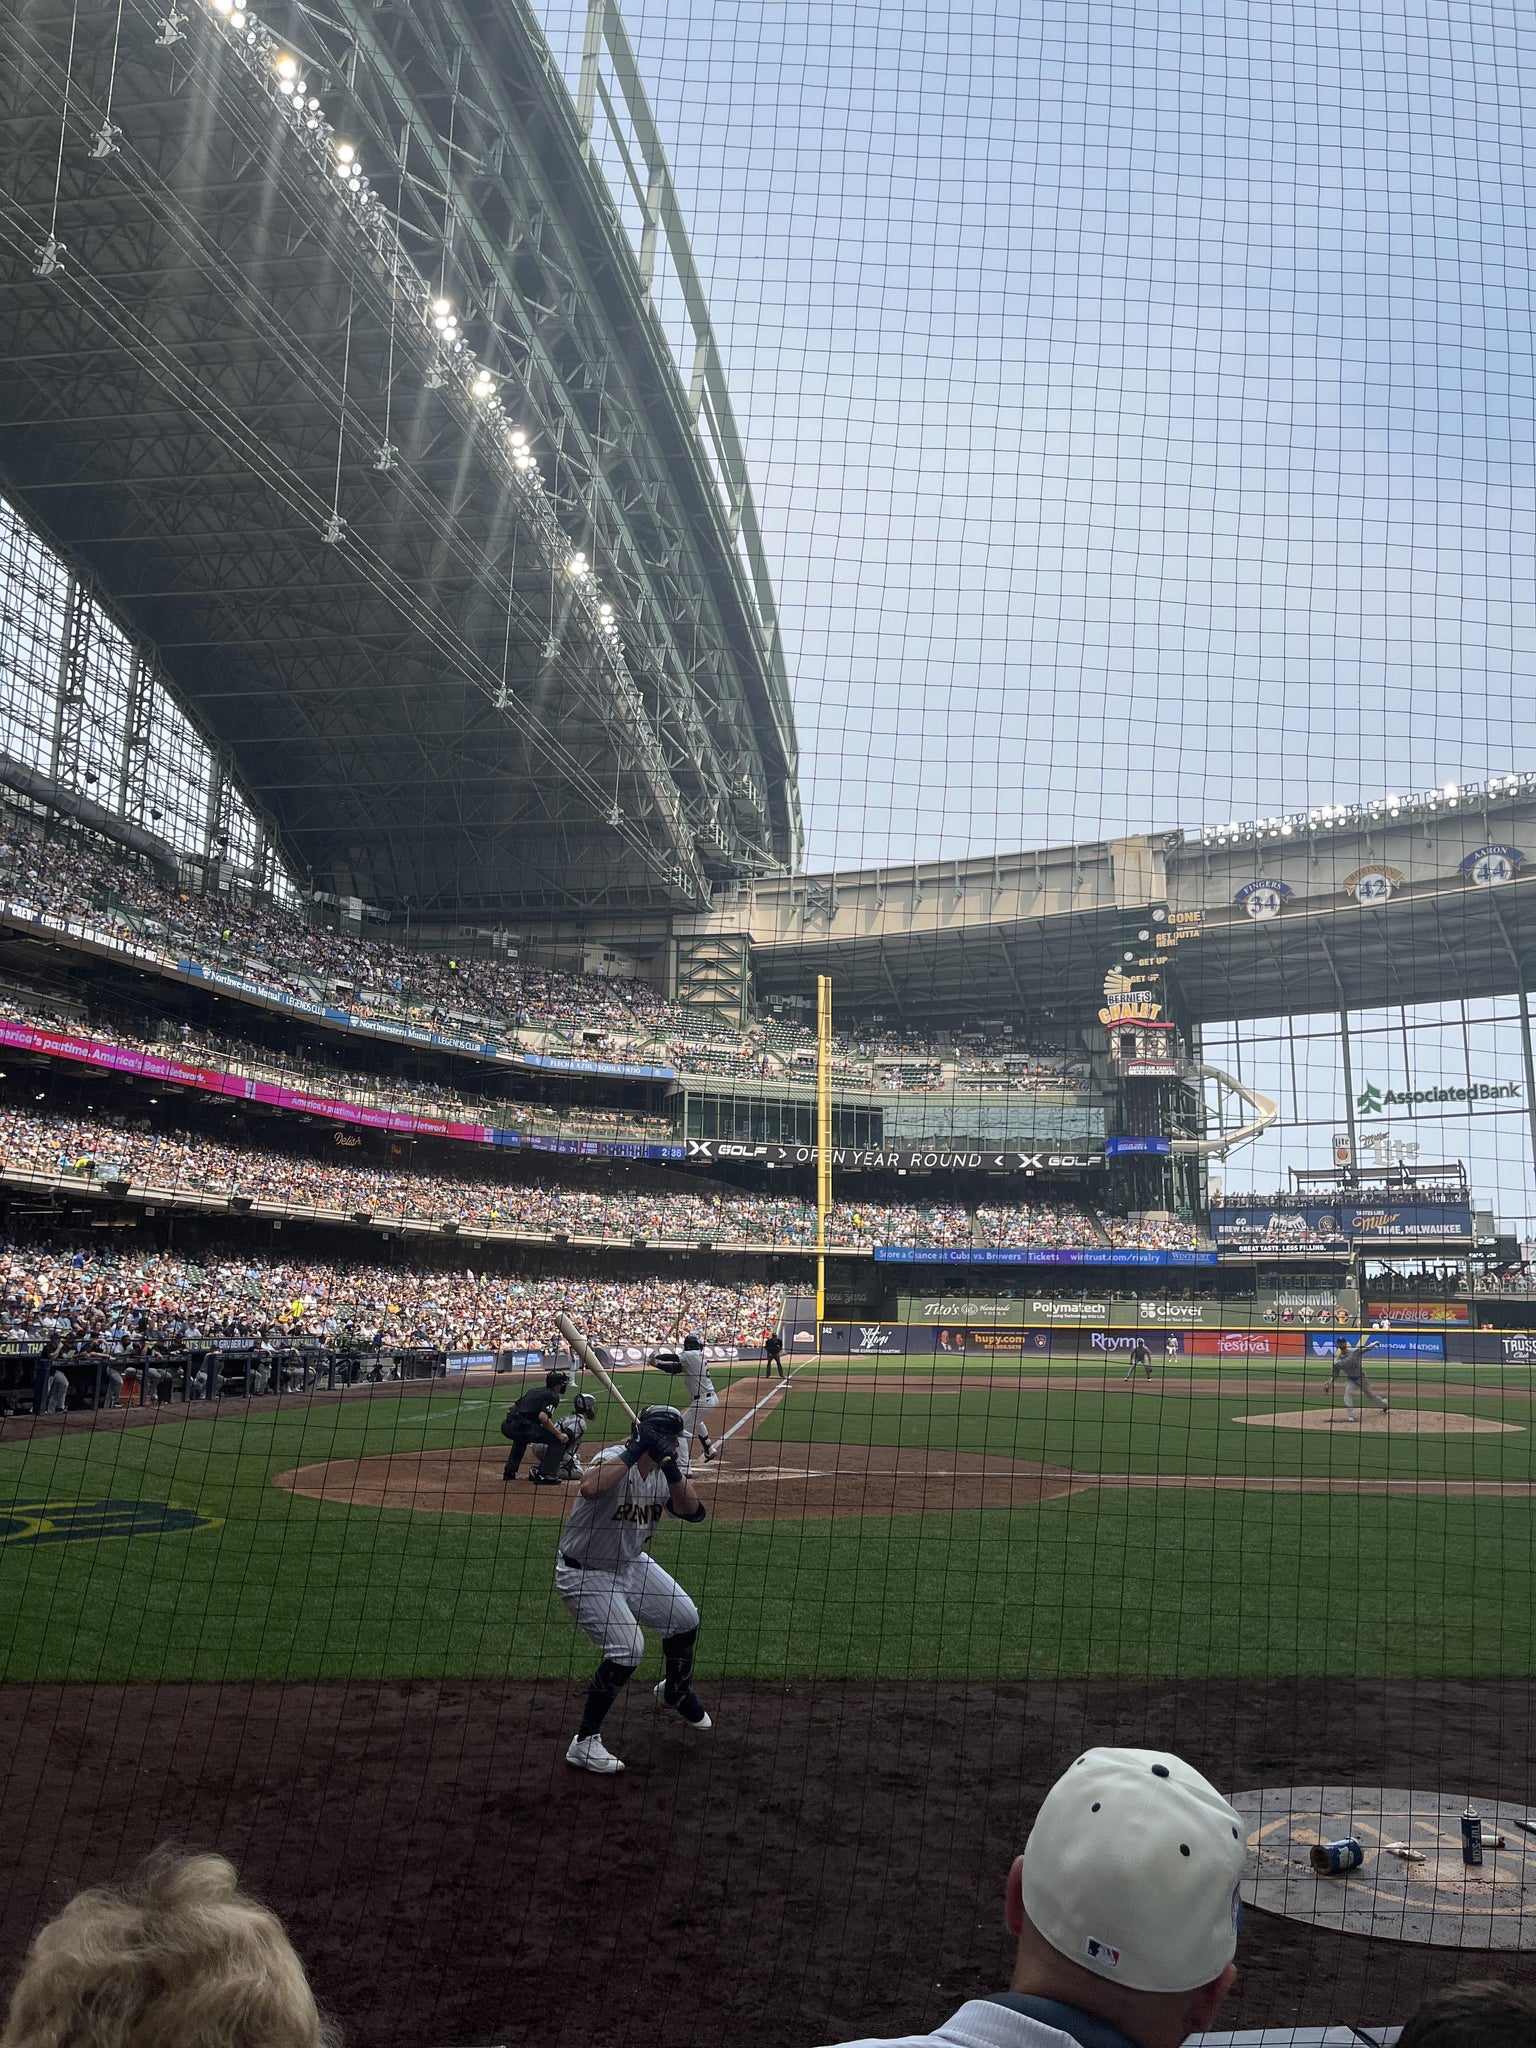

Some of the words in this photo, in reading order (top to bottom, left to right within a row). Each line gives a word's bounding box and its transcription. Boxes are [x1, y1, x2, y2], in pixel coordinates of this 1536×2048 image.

[1474, 846, 1508, 859] AARON
[1350, 864, 1396, 881] ROBINSON
[1477, 860, 1507, 881] 44
[1243, 880, 1282, 895] FINGERS
[1359, 879, 1387, 898] 42
[1250, 894, 1276, 913] 34
[1167, 911, 1206, 924] GONE!
[1155, 932, 1174, 941] GET
[1175, 929, 1200, 939] OUTTA
[1138, 957, 1154, 967] GET
[1156, 956, 1169, 965] UP
[1130, 974, 1146, 983] GET
[1148, 973, 1160, 982] UP
[210, 972, 256, 994] Northwestern
[257, 986, 280, 1001] Mutual
[1107, 991, 1152, 1006] BERNIE'S
[286, 996, 311, 1013] LEGENDS
[311, 1004, 326, 1017] CLUB
[1098, 1003, 1162, 1025] CHALET
[359, 1019, 407, 1037] Northwestern
[408, 1030, 432, 1042] Mutual
[438, 1036, 465, 1049] LEGENDS
[465, 1043, 481, 1052] CLUB
[94, 1049, 142, 1070] America's
[550, 1059, 574, 1069] FLECHA
[576, 1062, 593, 1071] AZUL
[292, 1097, 326, 1114] America's
[357, 1111, 393, 1126] America's
[688, 1141, 713, 1156] X
[718, 1145, 768, 1156] GOLF
[1335, 1137, 1349, 1146] Lite
[661, 1148, 681, 1157] 2:36
[852, 1150, 899, 1167] YEAR
[910, 1153, 982, 1167] ROUND
[1372, 1139, 1419, 1166] Lite
[1018, 1154, 1044, 1168] X
[1048, 1156, 1102, 1166] GOLF
[1218, 1225, 1240, 1233] BREW
[1235, 1217, 1247, 1226] GO
[1352, 1213, 1400, 1233] Miller
[1378, 1225, 1404, 1236] TIME,
[1405, 1224, 1462, 1234] MILWAUKEE
[878, 1251, 900, 1259] Score
[907, 1251, 936, 1260] Chance
[950, 1252, 971, 1260] Cubs
[1028, 1252, 1060, 1261] Tickets
[1070, 1252, 1160, 1263] wintrust.com/rivalry
[1273, 1290, 1337, 1306] Johnsonville
[1033, 1302, 1106, 1314] Polymatech
[1157, 1302, 1203, 1316] clover
[1378, 1306, 1429, 1320] Surfside
[974, 1334, 1025, 1345] hupy.com
[1218, 1338, 1270, 1353] festival
[1409, 1342, 1440, 1351] NATION
